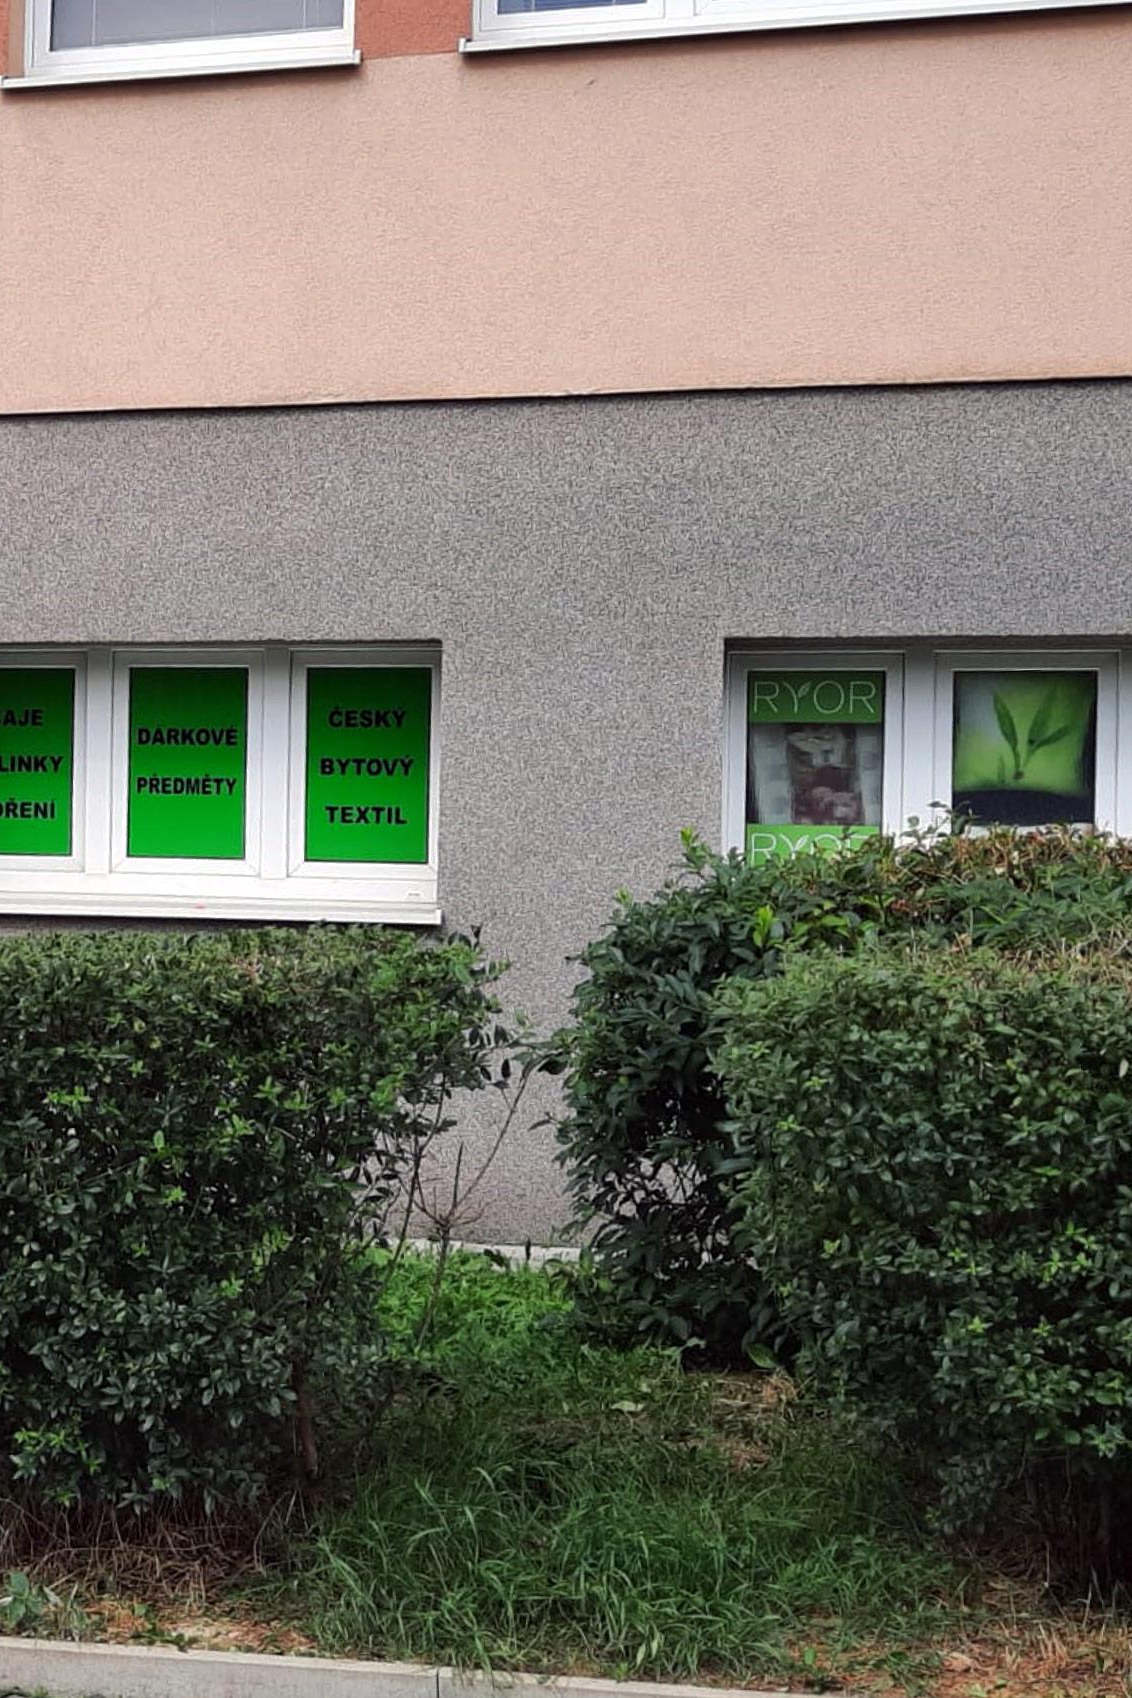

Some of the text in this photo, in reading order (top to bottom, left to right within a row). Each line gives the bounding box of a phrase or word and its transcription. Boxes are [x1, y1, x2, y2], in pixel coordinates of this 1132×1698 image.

[752, 680, 877, 715] RYOR
[328, 705, 407, 729] ČESKÝ
[137, 725, 238, 746] DÁRKOVÉ
[319, 754, 415, 777] BYTOVÝ
[136, 773, 237, 796] PŘEDMĚTY
[325, 805, 408, 826] TEXTIL
